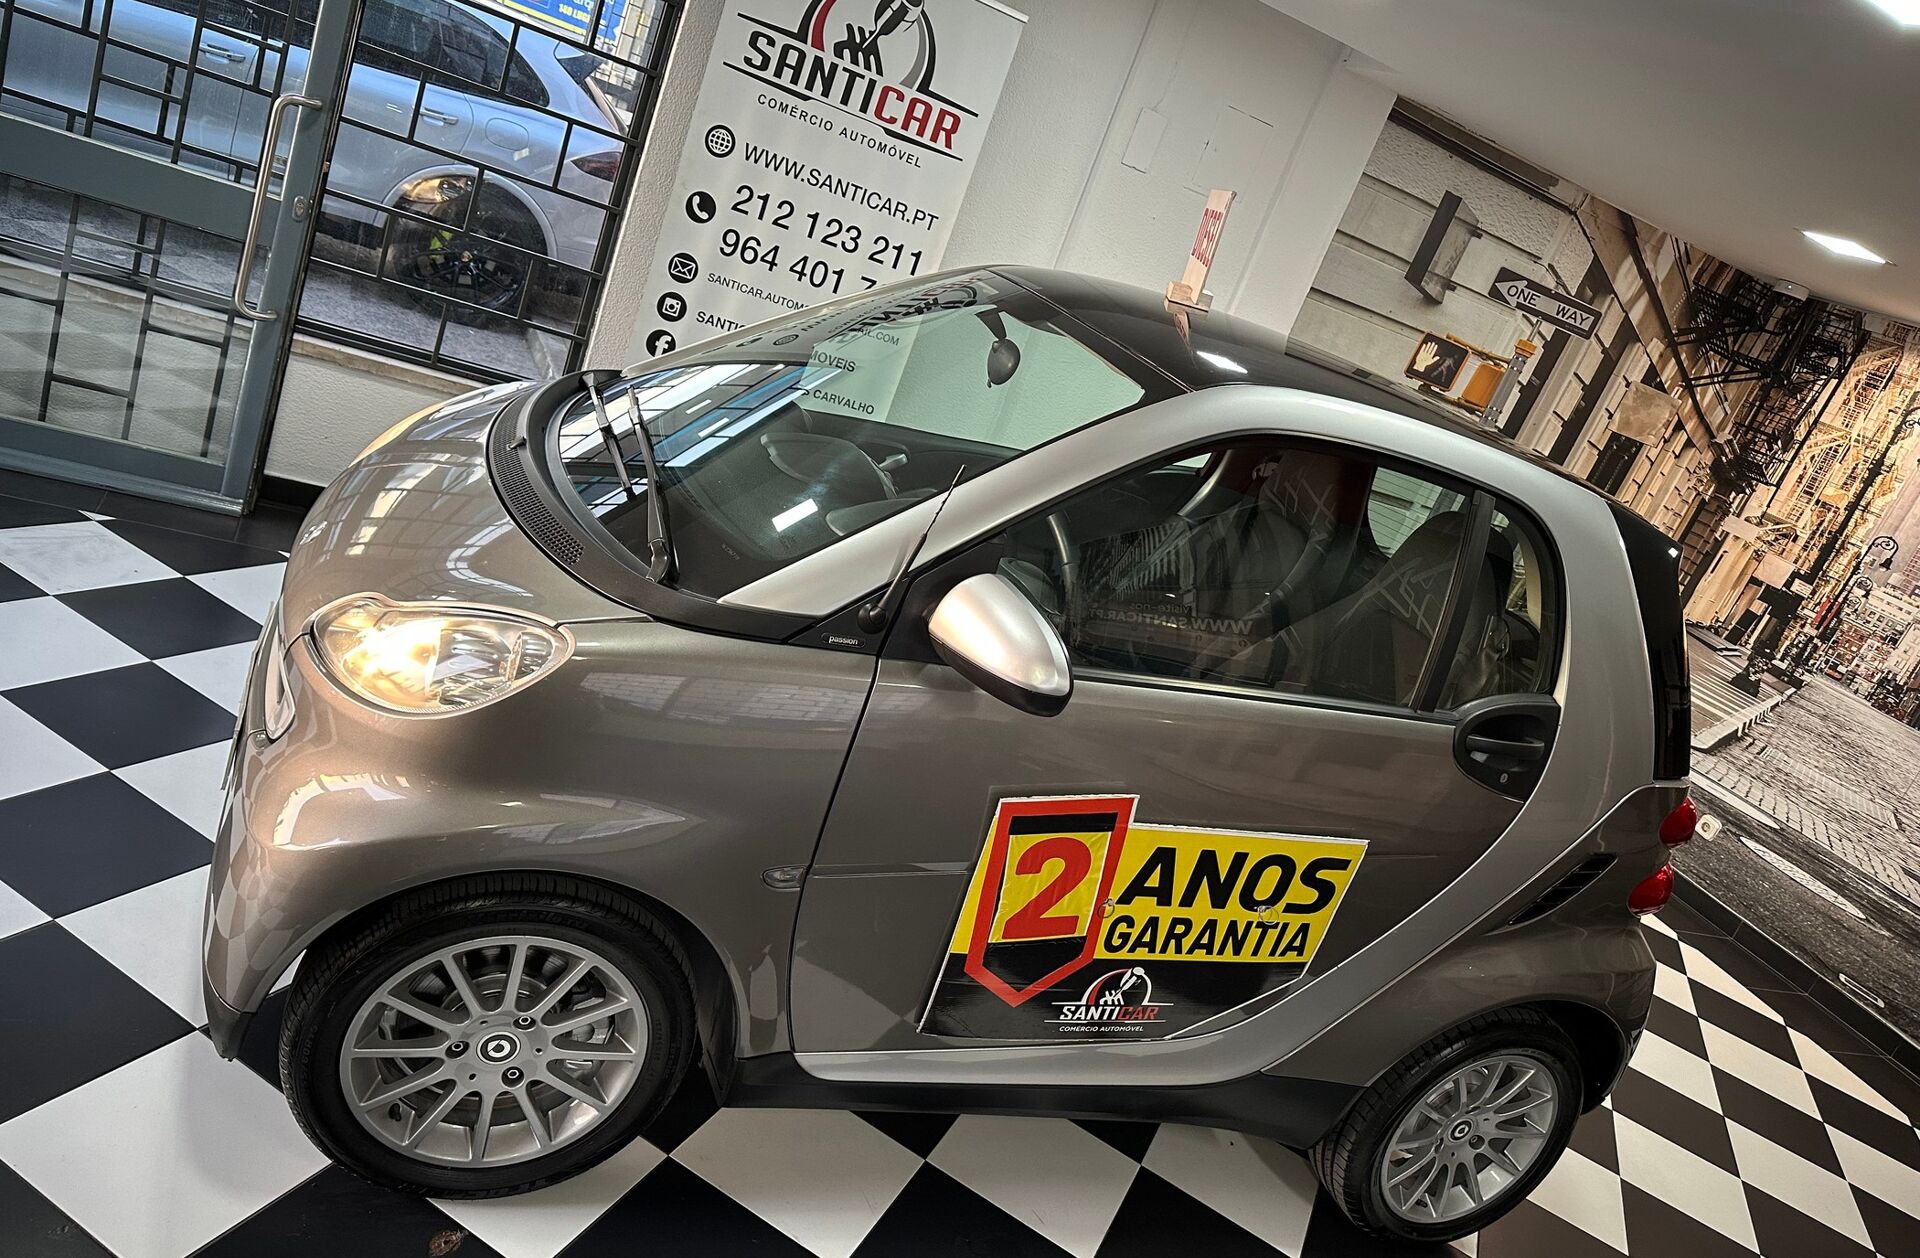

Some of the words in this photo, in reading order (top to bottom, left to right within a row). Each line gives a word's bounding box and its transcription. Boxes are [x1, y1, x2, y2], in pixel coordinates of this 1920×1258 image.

[743, 30, 962, 150] SANTICAR
[757, 93, 834, 132] COMÉRCIO
[839, 126, 922, 168] AUTOMÓVEL
[744, 142, 939, 231] WWW.SANTICAR.PT
[731, 184, 795, 230] 212
[807, 211, 862, 253] 123
[868, 235, 923, 276] 211
[1191, 208, 1224, 268] DIESEL
[719, 228, 780, 272] 964
[789, 256, 845, 294] 401
[707, 273, 809, 311] SANTICAR.AUTOM
[1507, 285, 1541, 307] ONE
[1555, 304, 1590, 326] WAY
[696, 311, 746, 332] SANTI
[813, 389, 875, 415] CARVALHO
[829, 636, 858, 645] passion
[1001, 836, 1092, 940] 2
[1115, 846, 1353, 916] ANOS
[1103, 914, 1312, 957] GARANTIA
[1060, 1005, 1160, 1020] SANTICAR
